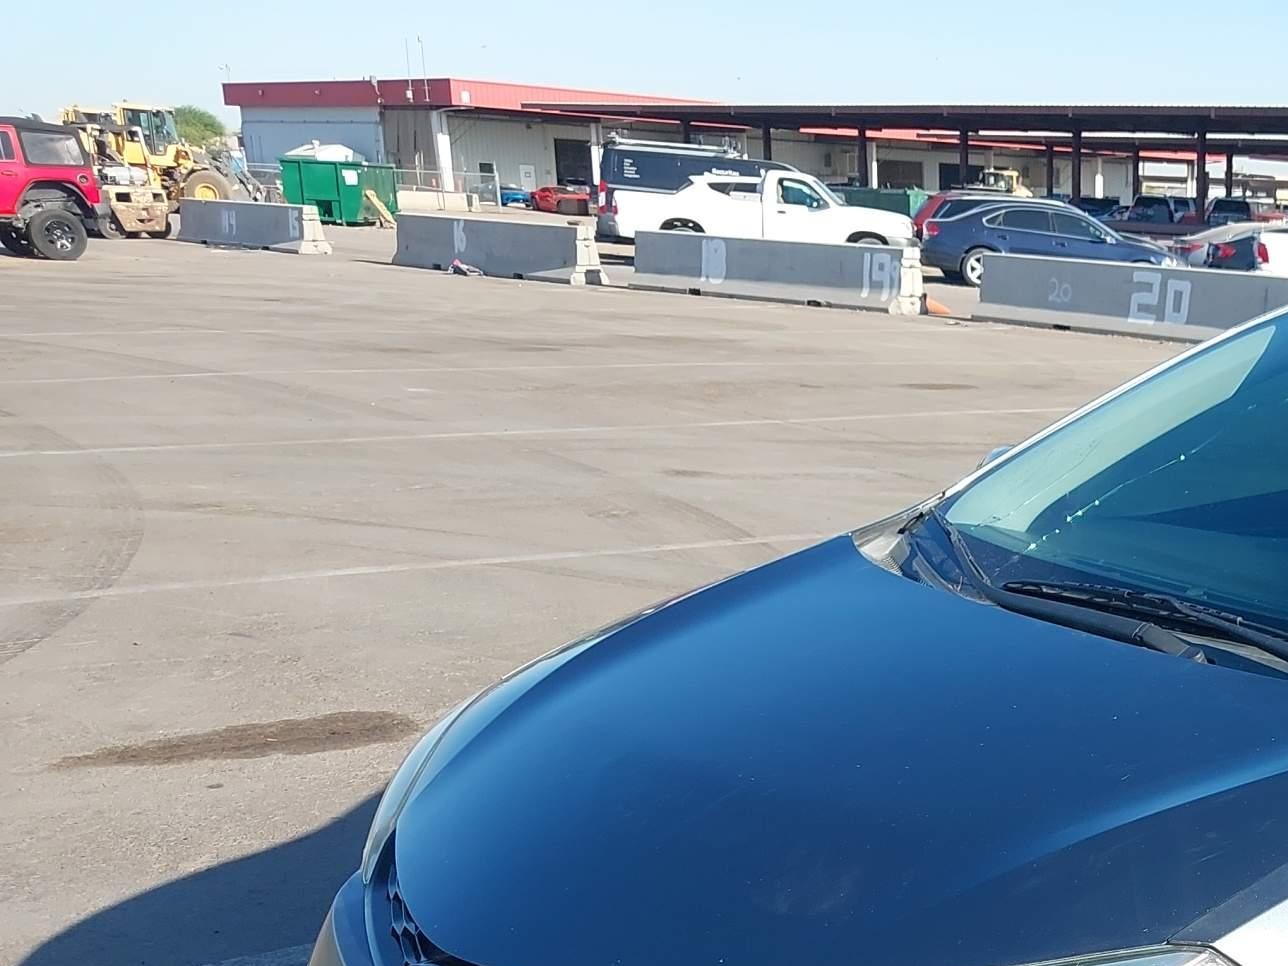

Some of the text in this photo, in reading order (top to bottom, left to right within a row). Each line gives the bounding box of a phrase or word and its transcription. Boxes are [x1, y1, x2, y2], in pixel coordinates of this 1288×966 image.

[453, 219, 466, 253] 16
[1048, 278, 1072, 302] 20
[1127, 271, 1192, 326] 20
